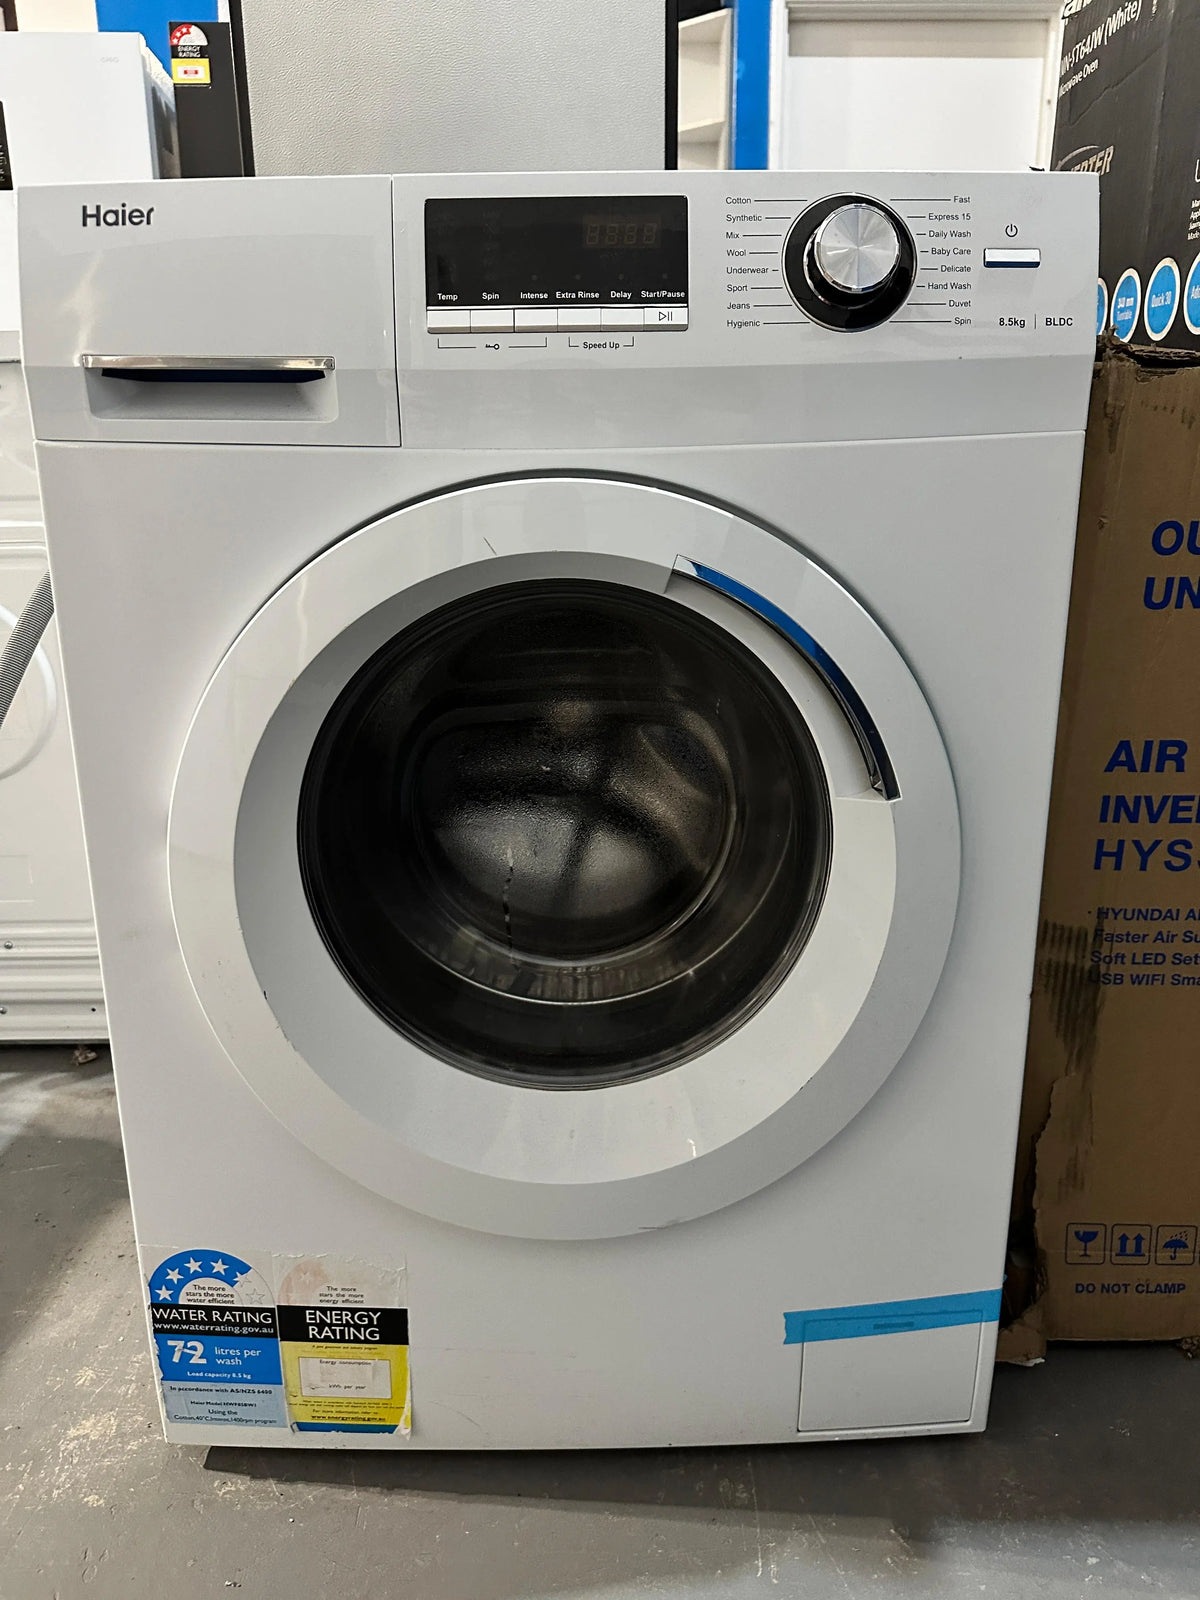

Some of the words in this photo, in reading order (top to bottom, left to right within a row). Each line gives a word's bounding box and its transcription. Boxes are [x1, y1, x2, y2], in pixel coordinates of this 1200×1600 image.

[1104, 0, 1141, 45] (White)
[1083, 59, 1099, 78] Oven
[725, 197, 752, 205] Cotton
[953, 196, 971, 204] Fast
[82, 203, 154, 227] Haier
[726, 214, 762, 222] Synthetic
[928, 213, 959, 222] Express
[962, 213, 971, 221] 15
[726, 231, 740, 239] Mix
[928, 230, 947, 239] Daily
[949, 230, 971, 238] Wash
[726, 249, 747, 257] Wool
[931, 248, 950, 257] Baby
[953, 247, 971, 256] Care
[726, 266, 769, 274] Underwear
[940, 265, 971, 273] Delicate
[726, 284, 748, 293] Sport
[927, 282, 946, 290] Hand
[948, 282, 971, 290] Wash
[437, 293, 458, 301] Temp
[482, 292, 500, 301] Spin
[520, 291, 549, 299] Intense
[556, 291, 575, 299] Extra
[576, 291, 600, 299] Rinse
[610, 290, 632, 300] Delay
[641, 290, 685, 298] Start/Pause
[727, 302, 750, 310] Jeans
[949, 300, 971, 308] Duvet
[727, 319, 760, 328] Hygienic
[954, 317, 971, 326] Spin
[999, 317, 1026, 328] 8.5kg
[1045, 317, 1073, 327] BLDC
[583, 341, 606, 350] Speed
[608, 341, 620, 350] Up
[1143, 576, 1200, 610] UN
[1104, 740, 1188, 773] AIR
[1099, 795, 1200, 824] INVE
[1094, 839, 1200, 872] HYS
[1097, 907, 1180, 921] HYUNDAI
[1093, 929, 1149, 943] Faster
[1153, 930, 1178, 943] Air
[1090, 951, 1126, 965] Soft
[1131, 952, 1167, 965] LED
[1130, 973, 1165, 986] WIFI
[1075, 1283, 1096, 1294] DO
[1101, 1283, 1131, 1294] NOT
[1135, 1283, 1186, 1294] CLAMP
[153, 1308, 208, 1321] WATER
[212, 1311, 272, 1324] RATING
[305, 1310, 381, 1325] ENERGY
[154, 1323, 274, 1334] www.waterrating.gov.au
[309, 1326, 380, 1341] RATING
[167, 1340, 207, 1364] 72
[215, 1346, 241, 1355] litres
[244, 1350, 261, 1358] per
[216, 1357, 242, 1365] wash
